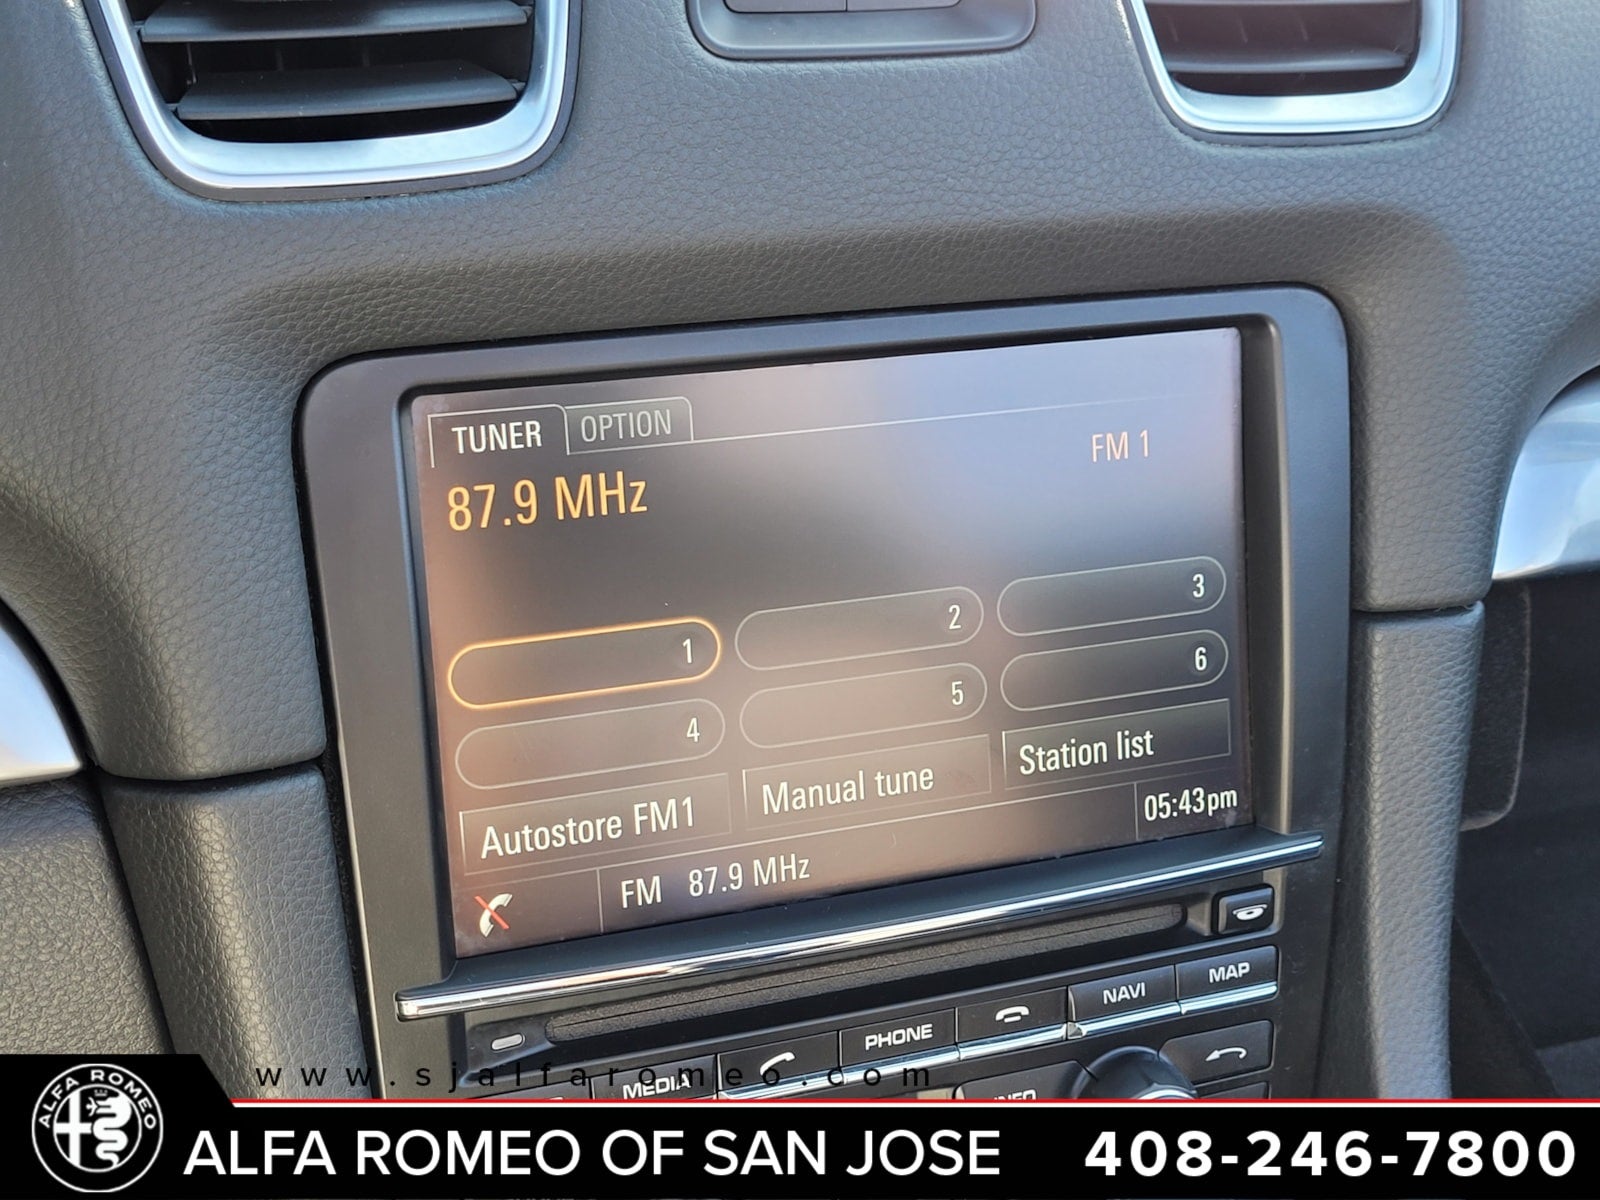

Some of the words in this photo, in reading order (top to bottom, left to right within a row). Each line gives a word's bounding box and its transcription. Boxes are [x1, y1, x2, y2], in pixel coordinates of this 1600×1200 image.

[451, 420, 542, 455] TUNER
[580, 409, 671, 442] OPTION
[1091, 431, 1128, 462] FM
[1139, 430, 1150, 457] 1
[447, 479, 538, 531] 87.9
[554, 470, 648, 520] MHz
[1192, 573, 1206, 598] 3
[948, 605, 962, 630] 2
[681, 637, 693, 664] 1
[1194, 646, 1208, 671] 6
[950, 681, 965, 706] 5
[686, 717, 701, 742] 4
[1018, 739, 1108, 775] Station
[1116, 729, 1155, 761] list
[761, 770, 866, 815] Manual
[874, 767, 935, 797] tune
[1143, 787, 1239, 822] 05:43pm
[481, 814, 623, 859] Autostore
[633, 796, 695, 835] FM1
[620, 875, 663, 909] FM
[688, 862, 744, 898] 87.9
[752, 853, 811, 886] MHz
[1208, 962, 1251, 983] MAP
[1102, 982, 1147, 1005] NAVI
[864, 1023, 934, 1052] PHONE
[622, 1072, 692, 1100] MEDIA
